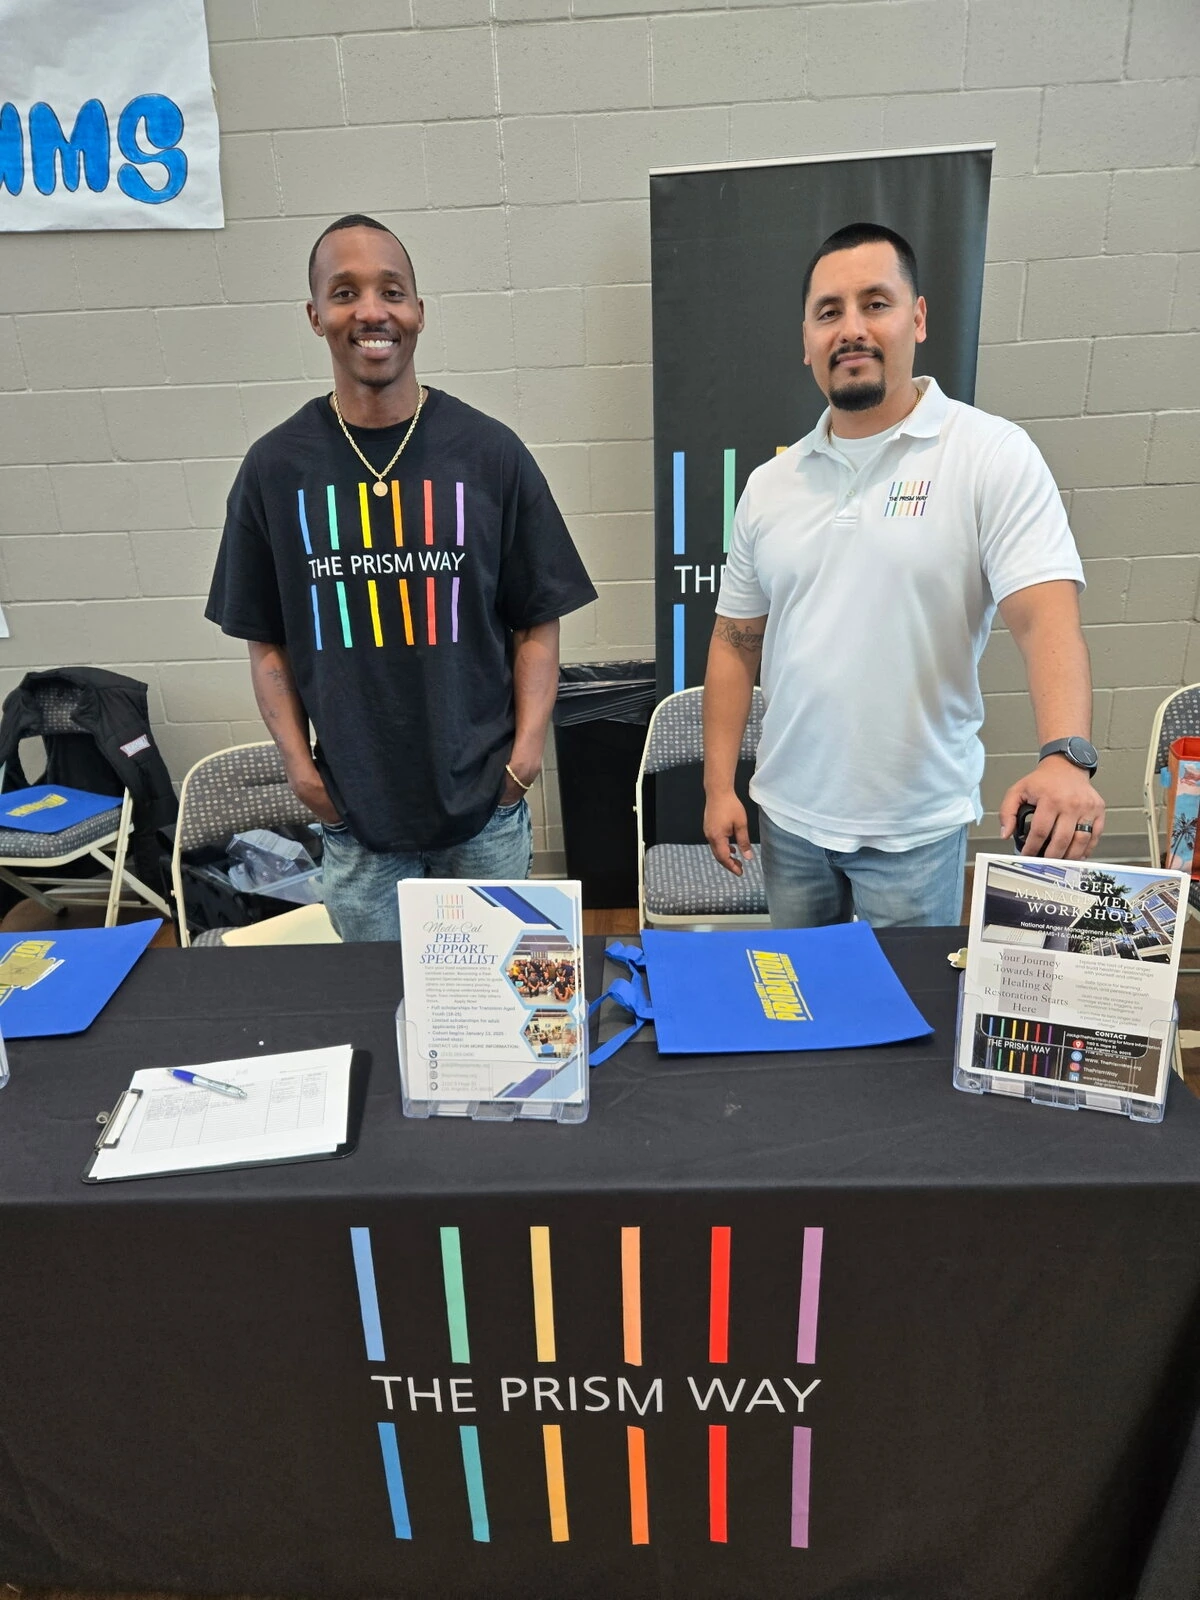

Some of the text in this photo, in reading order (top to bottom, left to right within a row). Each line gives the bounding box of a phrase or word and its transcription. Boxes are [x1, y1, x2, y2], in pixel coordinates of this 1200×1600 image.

[308, 551, 465, 578] THE PRISM WAY
[673, 565, 726, 594] TH
[1053, 879, 1115, 894] ANGER
[1015, 888, 1150, 911] MANAGEMENT
[1027, 901, 1134, 923] WORKSHOP
[1020, 921, 1046, 929] National
[1046, 924, 1063, 932] Anger
[435, 933, 471, 943] PEER
[424, 944, 489, 954] SUPPORT
[419, 954, 499, 965] SPECIALIST
[999, 952, 1061, 969] Your Journey
[994, 963, 1064, 980] Towards Hope
[752, 950, 807, 1021] PROBATION
[1002, 977, 1052, 991] Healing &
[984, 986, 1038, 1002] Restoration
[1040, 995, 1069, 1006] Starts
[1012, 1002, 1037, 1013] Here
[1094, 1031, 1127, 1040] CONTACT
[988, 1038, 1050, 1054] THE PRISM WAY
[371, 1375, 822, 1416] THE PRISM WAY
